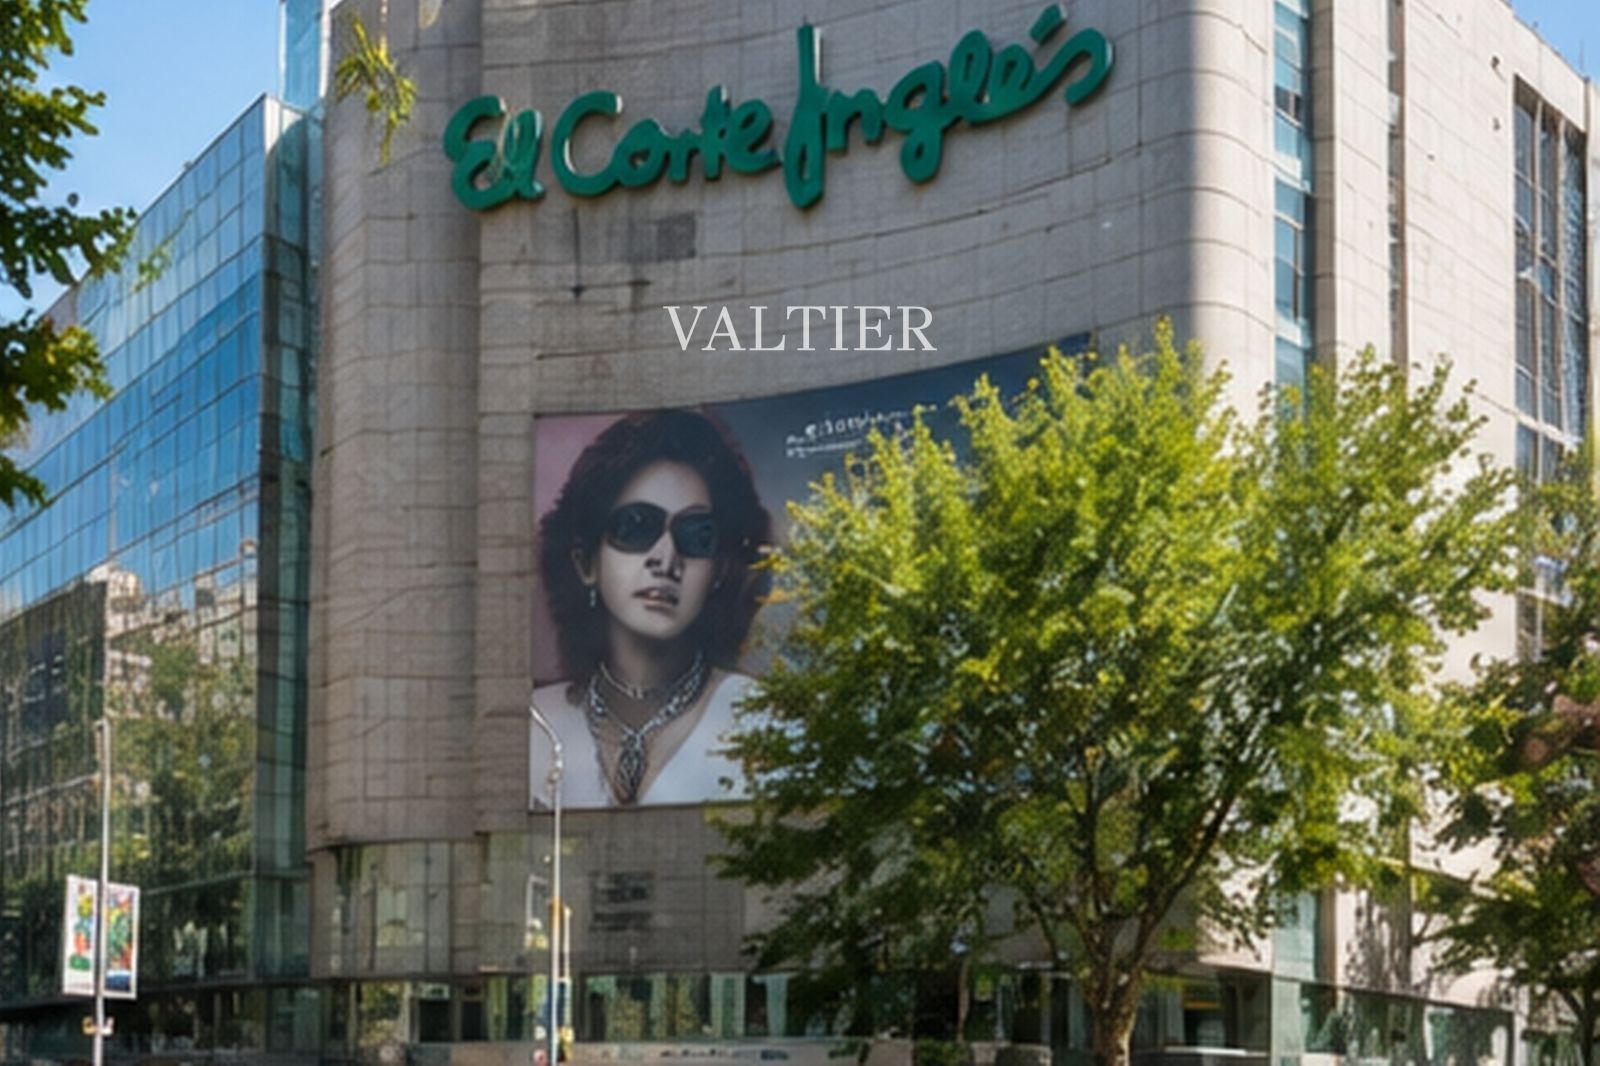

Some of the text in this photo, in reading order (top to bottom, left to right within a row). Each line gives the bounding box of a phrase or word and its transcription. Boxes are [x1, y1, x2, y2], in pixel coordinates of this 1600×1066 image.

[443, 4, 1115, 212] El Corte Inglés
